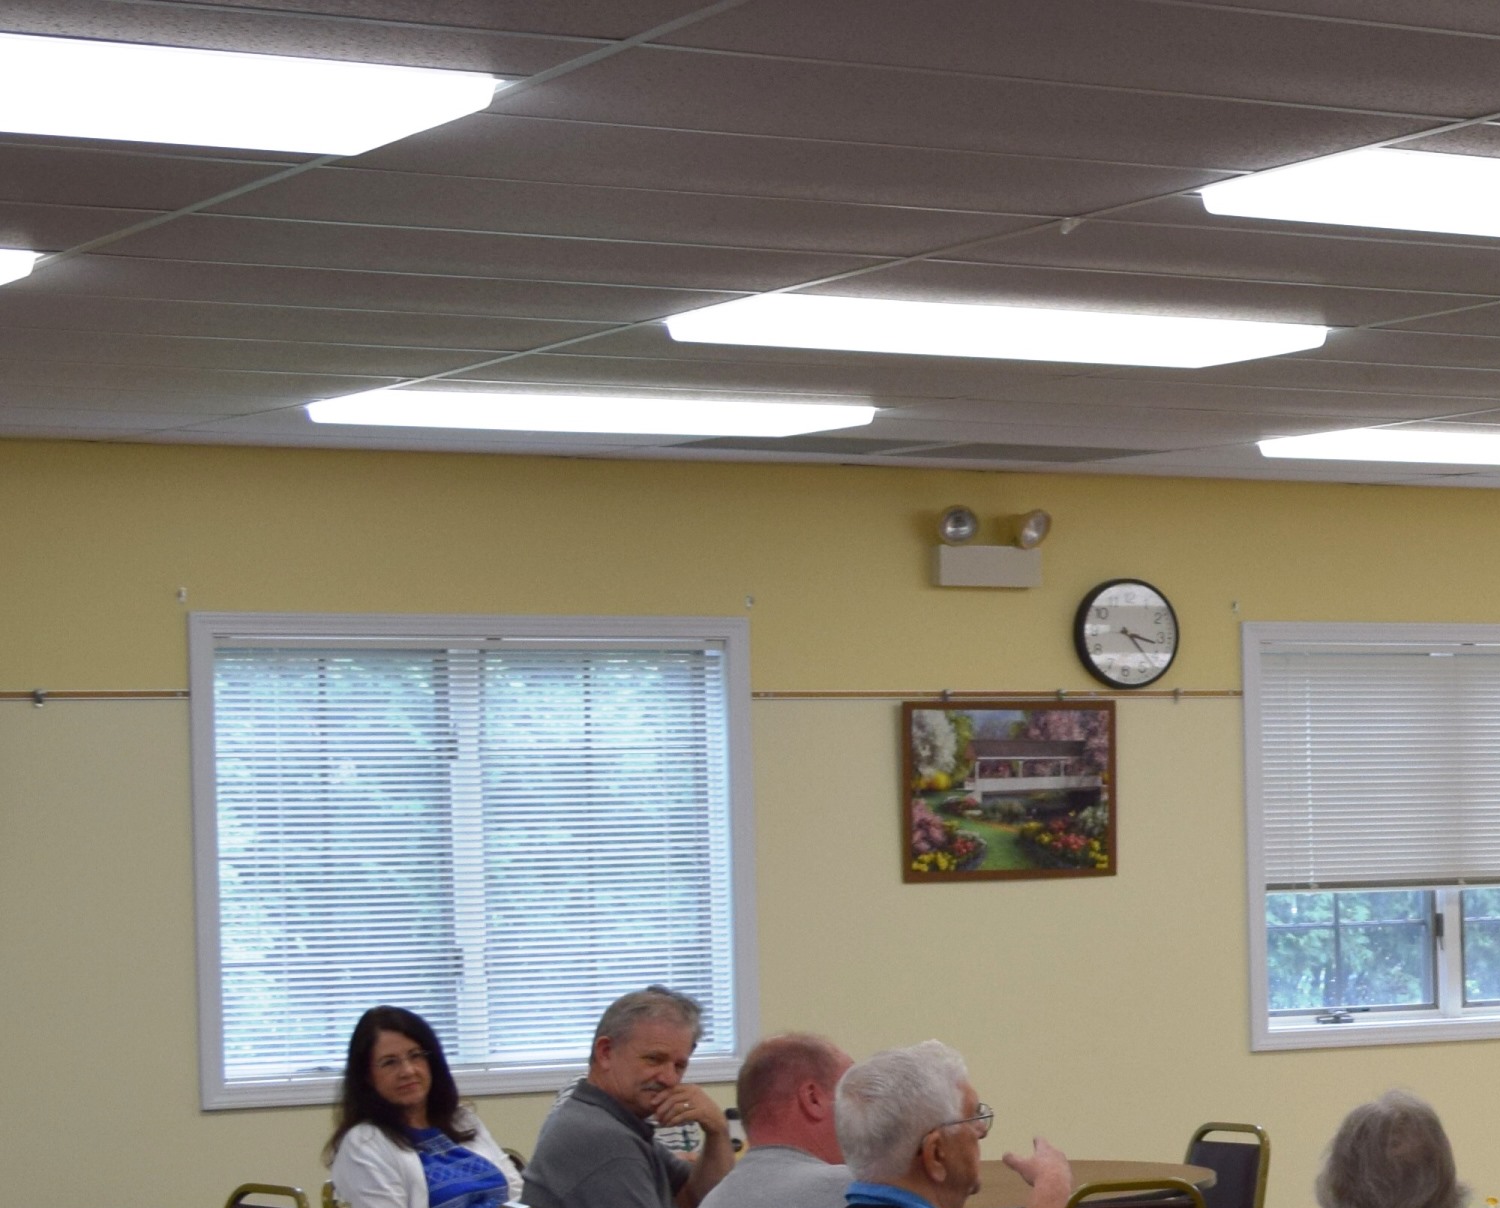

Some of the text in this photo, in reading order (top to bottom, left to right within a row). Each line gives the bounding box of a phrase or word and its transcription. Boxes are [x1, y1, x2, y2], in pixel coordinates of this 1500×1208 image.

[1095, 607, 1109, 620] 10
[1153, 612, 1162, 624] 2
[1156, 631, 1165, 644] 3
[1093, 643, 1103, 656] 8
[1121, 665, 1130, 677] 6
